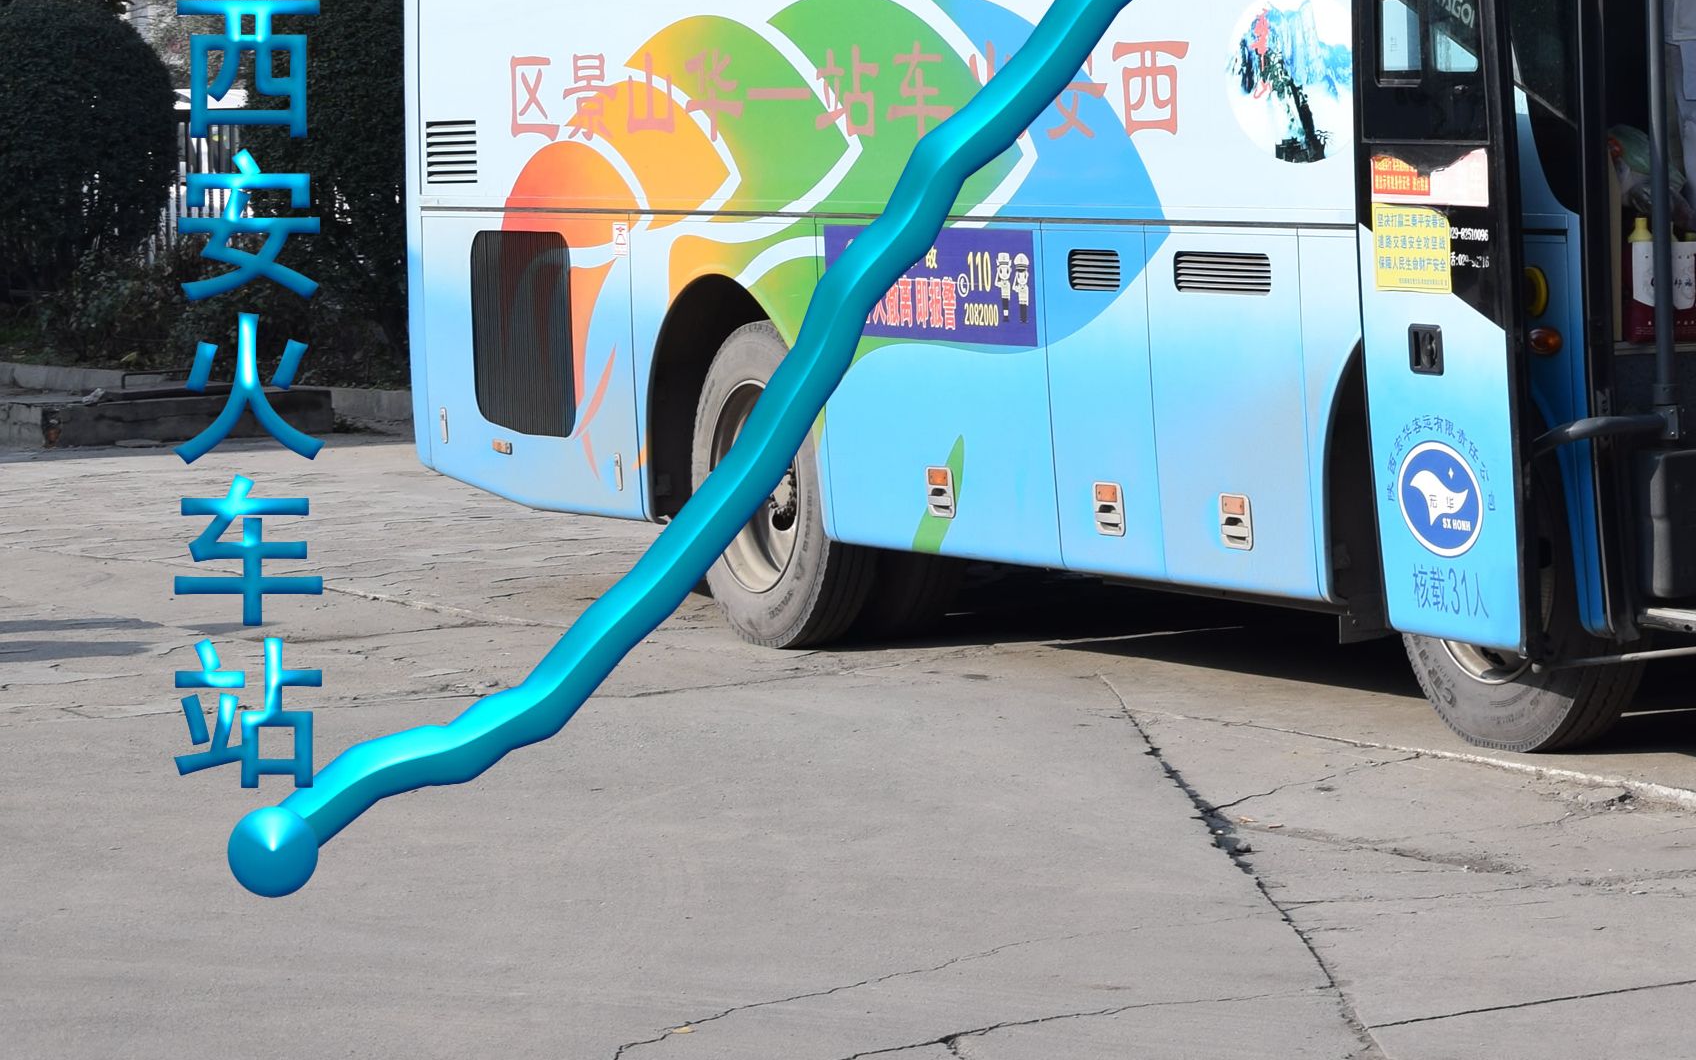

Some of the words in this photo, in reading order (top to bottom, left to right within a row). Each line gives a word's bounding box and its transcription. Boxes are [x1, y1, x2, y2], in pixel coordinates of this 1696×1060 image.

[967, 250, 992, 292] 110
[963, 302, 999, 327] 2082000
[1413, 563, 1489, 619] 核载31人
